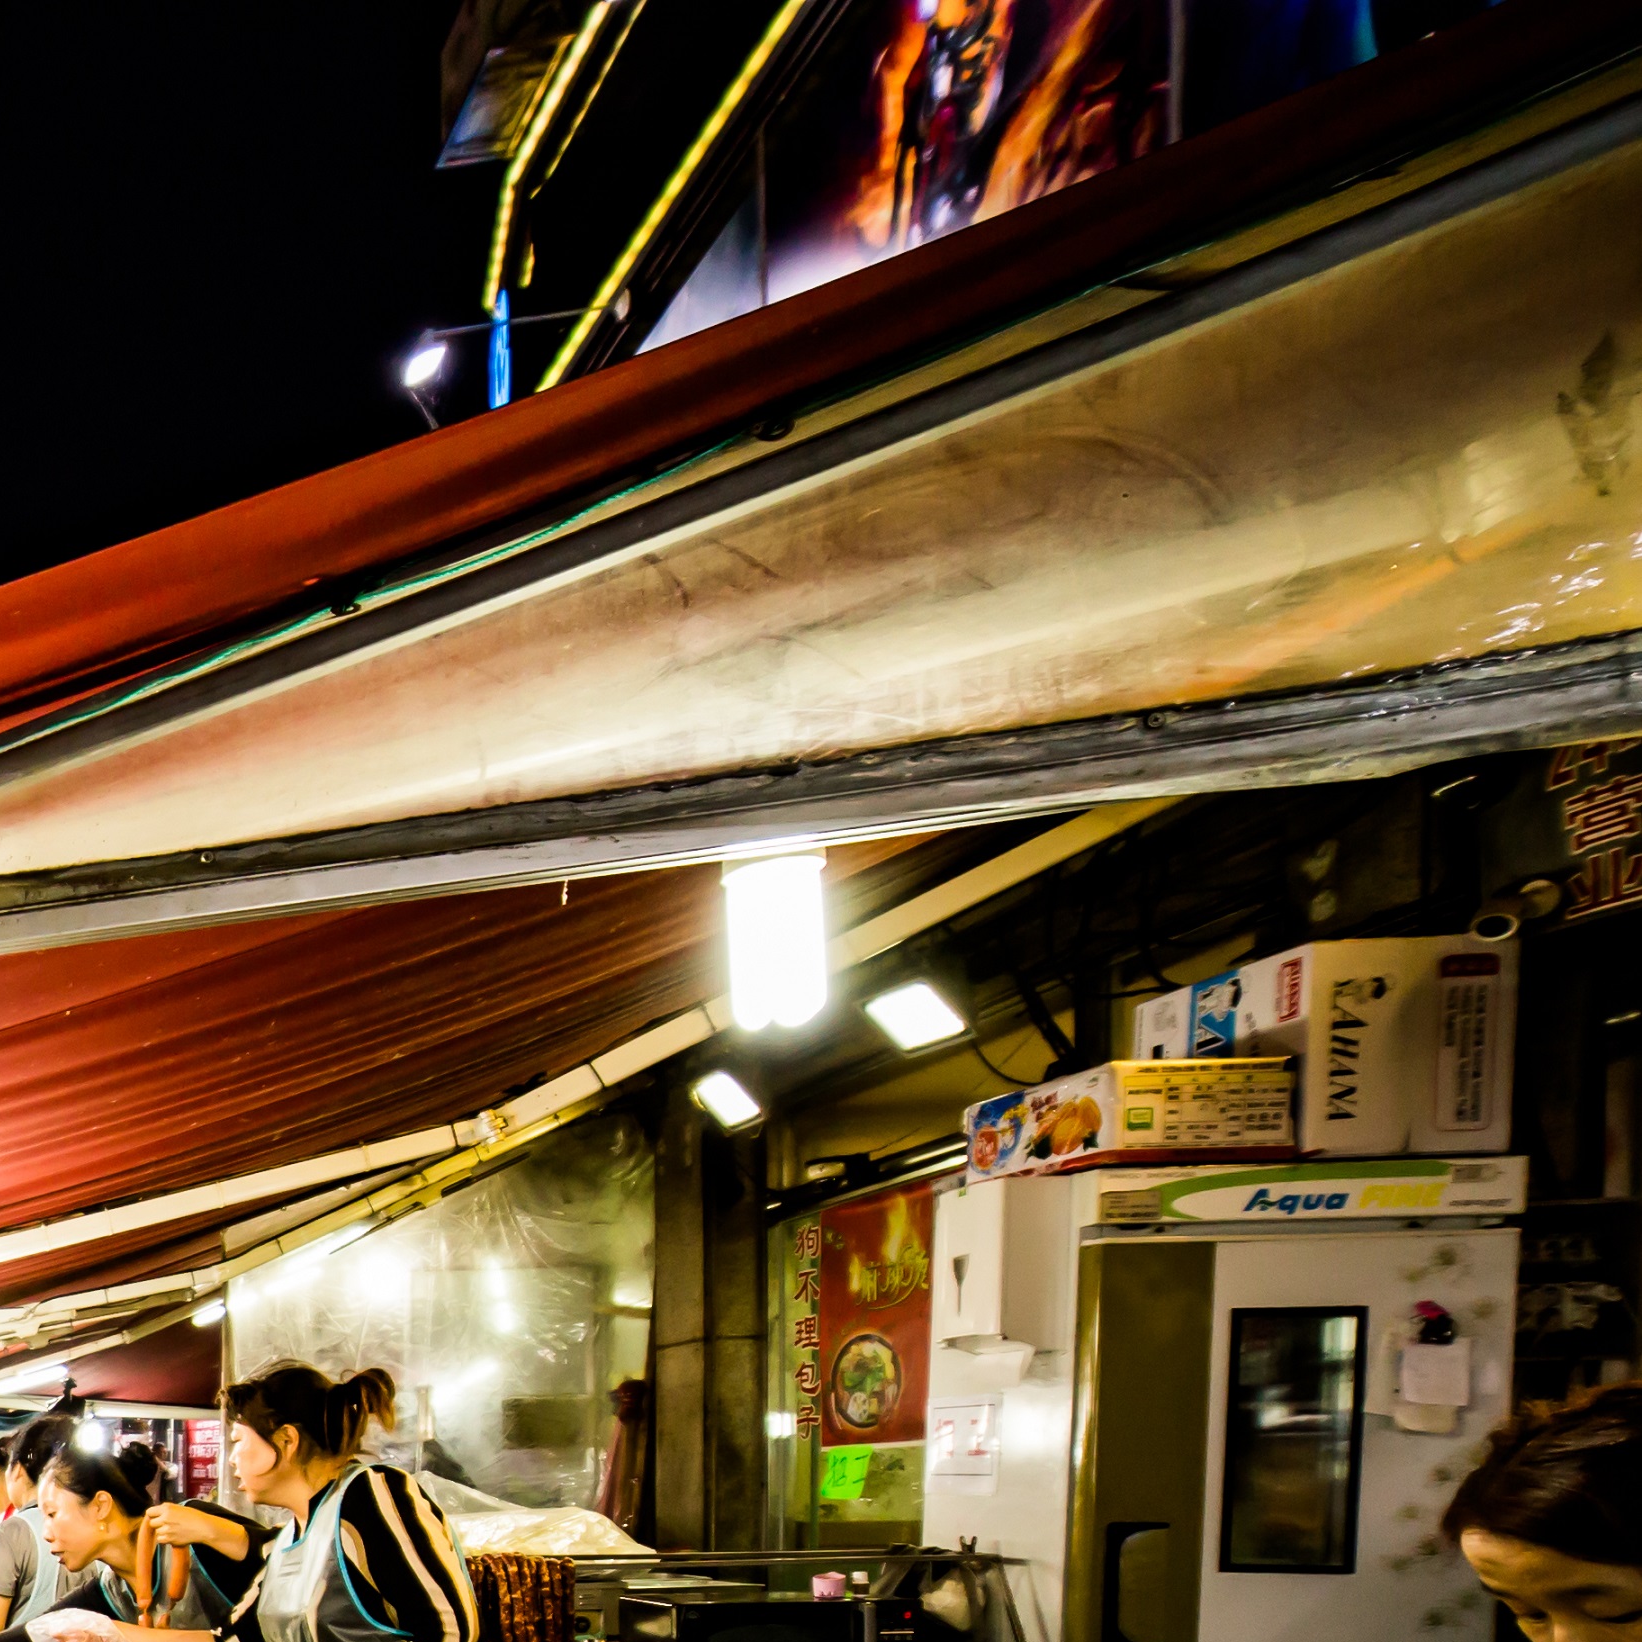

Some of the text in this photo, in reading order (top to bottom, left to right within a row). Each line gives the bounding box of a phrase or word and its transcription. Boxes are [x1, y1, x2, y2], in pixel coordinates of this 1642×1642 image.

[1242, 1188, 1350, 1215] Aqua
[794, 1223, 821, 1440] 狗不理包子
